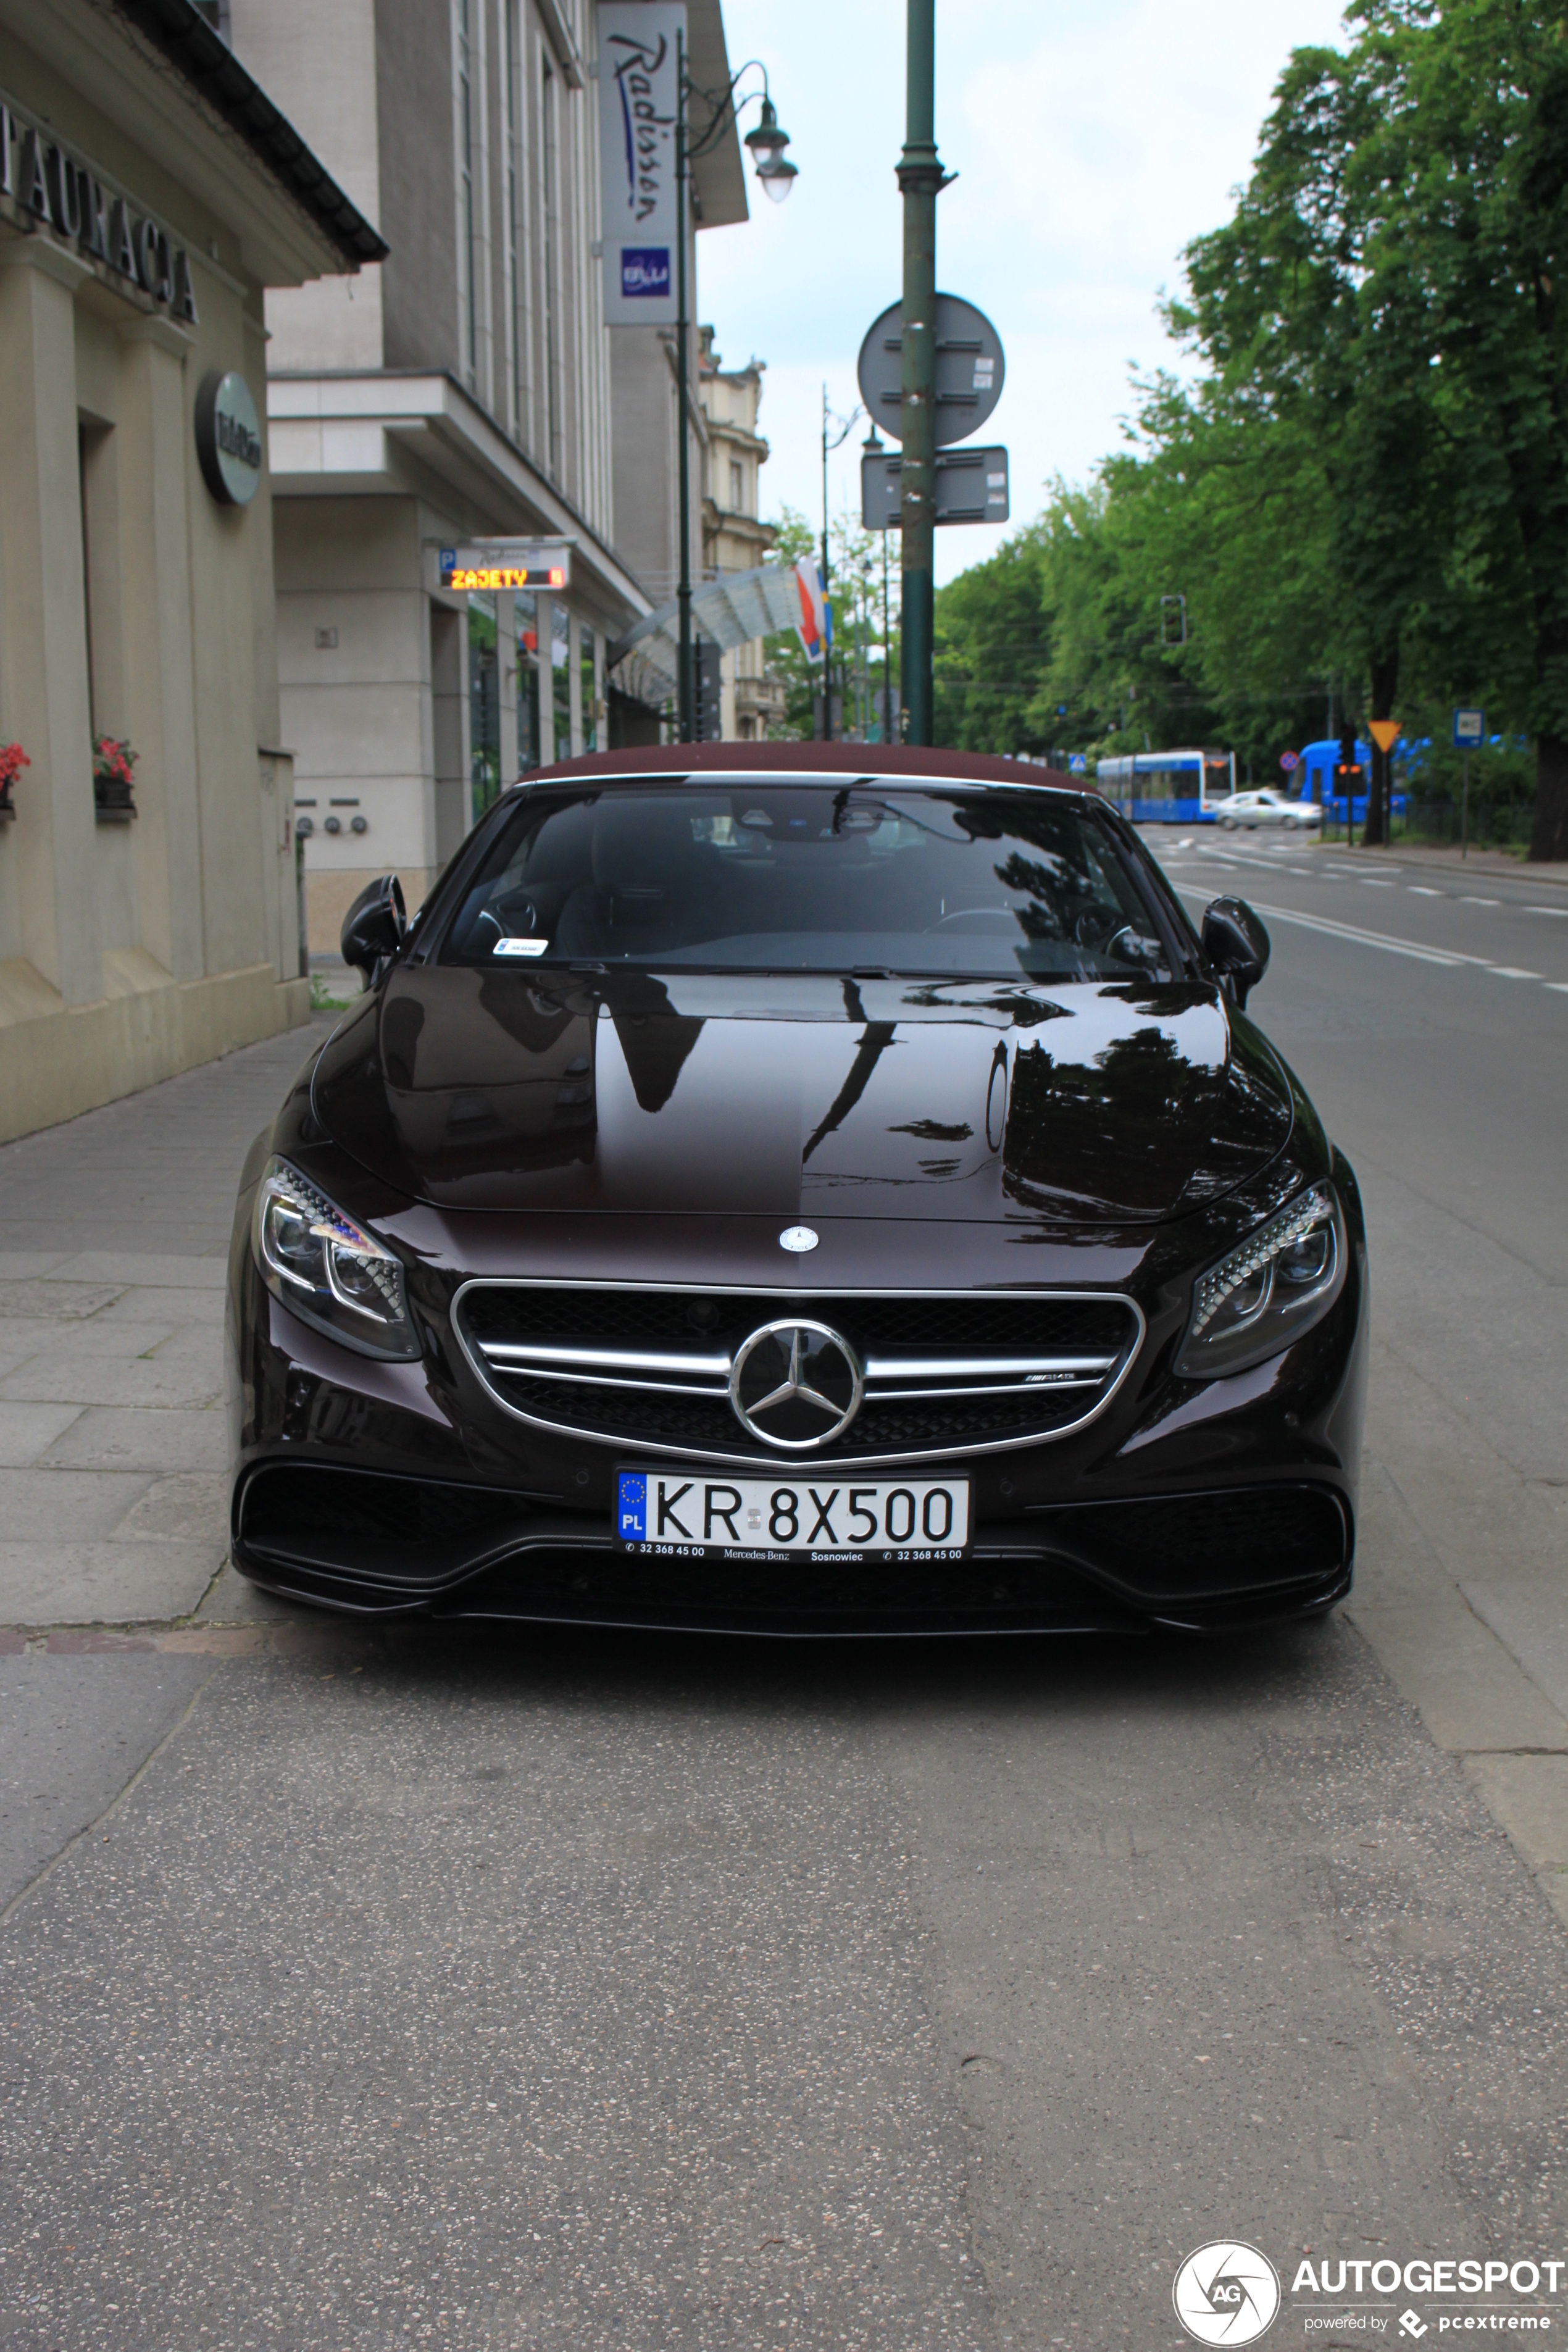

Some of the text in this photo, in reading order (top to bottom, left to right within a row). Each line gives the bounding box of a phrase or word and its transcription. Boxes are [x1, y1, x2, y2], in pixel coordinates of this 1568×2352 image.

[607, 33, 675, 222] Radisson
[622, 1514, 643, 1530] PL
[657, 1481, 953, 1543] KR 8X500
[640, 1543, 962, 1561] 32 368 45 00 Mercedes-Benz Sosnowiec 32 368 45 00
